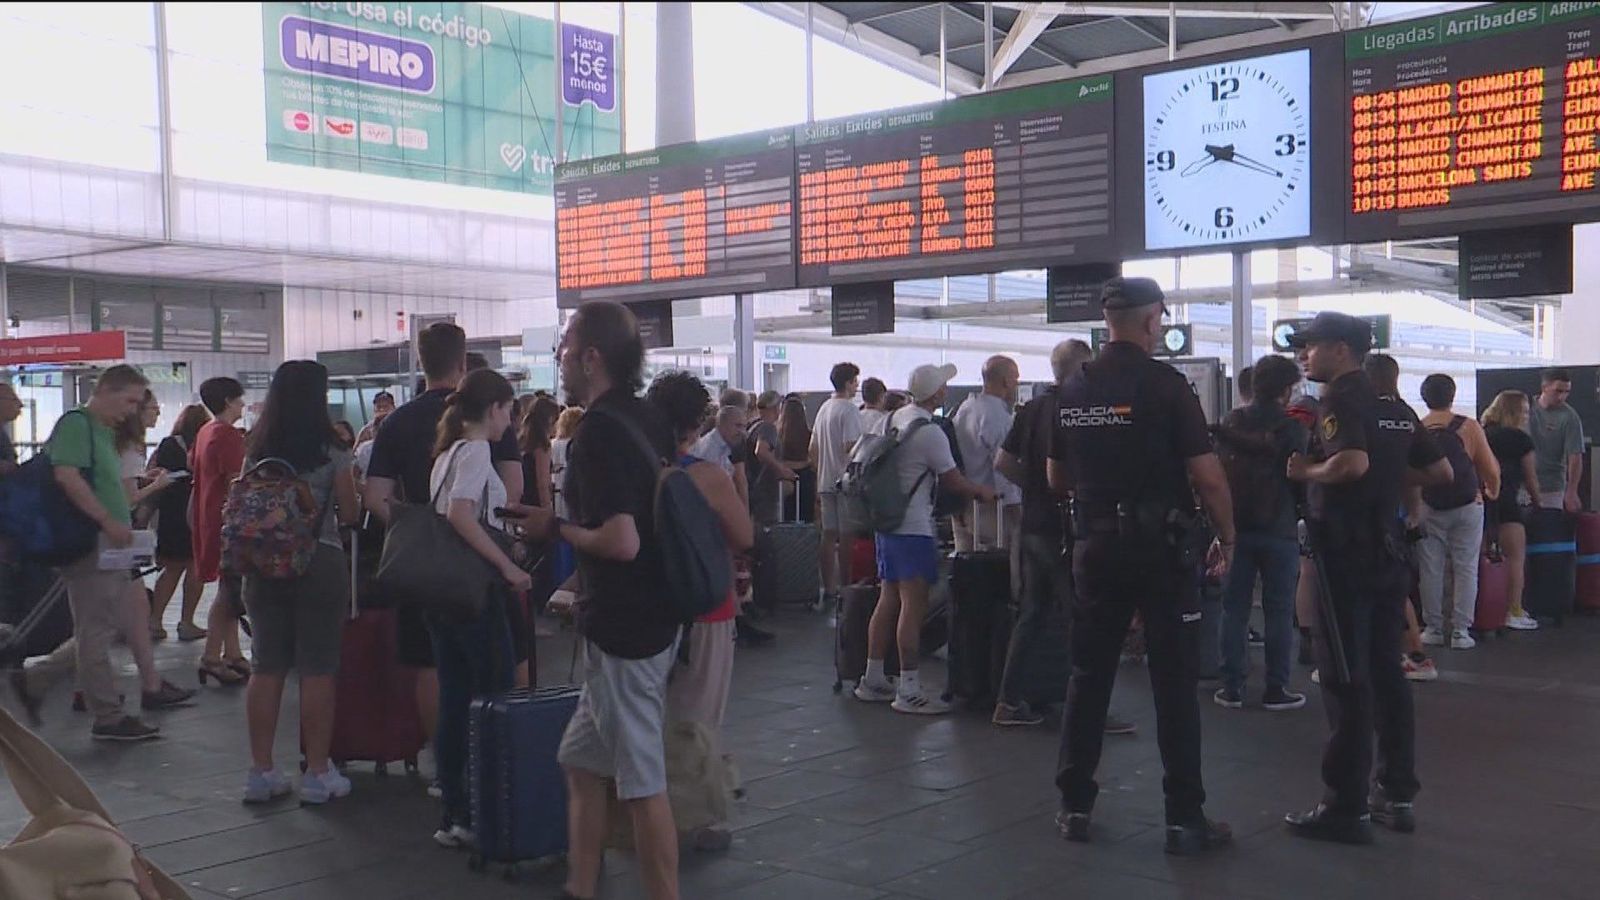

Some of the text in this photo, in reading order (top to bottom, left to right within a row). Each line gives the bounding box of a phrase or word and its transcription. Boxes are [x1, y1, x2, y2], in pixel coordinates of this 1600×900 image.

[346, 2, 387, 24] Usa
[393, 6, 413, 29] el
[419, 13, 491, 48] código
[1364, 26, 1436, 50] Llegadas
[1446, 7, 1538, 36] Arribades
[1567, 29, 1591, 40] Tren
[295, 29, 424, 80] MEPIRO
[573, 34, 604, 53] Hasta
[1567, 40, 1591, 51] Tren
[570, 52, 607, 80] 15€
[1352, 68, 1372, 77] Hora
[570, 77, 607, 94] menos
[1207, 77, 1240, 101] 12
[1352, 77, 1372, 87] Hora
[1354, 92, 1396, 110] 08:26
[1399, 83, 1451, 105] MADRID
[1566, 58, 1600, 78] AVL
[805, 111, 934, 140] Salidas Eixides DEPARTURES
[1354, 109, 1396, 128] 08:34
[1399, 101, 1451, 122] MADRID
[1354, 126, 1396, 145] 09:00
[1399, 106, 1542, 138] ALACANT/ALICANTE
[1202, 119, 1247, 135] FESTINA
[1274, 134, 1296, 156] 3
[1354, 143, 1396, 161] 09:04
[1399, 136, 1451, 156] MADRID
[1354, 160, 1396, 178] 09:33
[1399, 153, 1450, 173] MADRID
[1563, 134, 1596, 153] AVE
[921, 156, 939, 169] AVE
[1156, 150, 1175, 172] 9
[921, 167, 961, 183] EUROMED
[1354, 177, 1396, 195] 10:02
[1399, 168, 1477, 191] BARCELONA
[1482, 161, 1533, 182] SANTS
[921, 184, 939, 197] AVE
[1354, 172, 1595, 212] 10:19 BURGOS AVE
[827, 207, 858, 222] MADRID
[922, 197, 945, 211] IRYO
[922, 210, 950, 224] ALVIA
[1214, 206, 1234, 228] 6
[828, 233, 858, 249] MADRID
[922, 225, 940, 238] AVE
[922, 238, 961, 253] EUROMED
[102, 307, 110, 318] 9
[1060, 405, 1115, 418] POLICIA
[1061, 415, 1132, 427] NACIONAL
